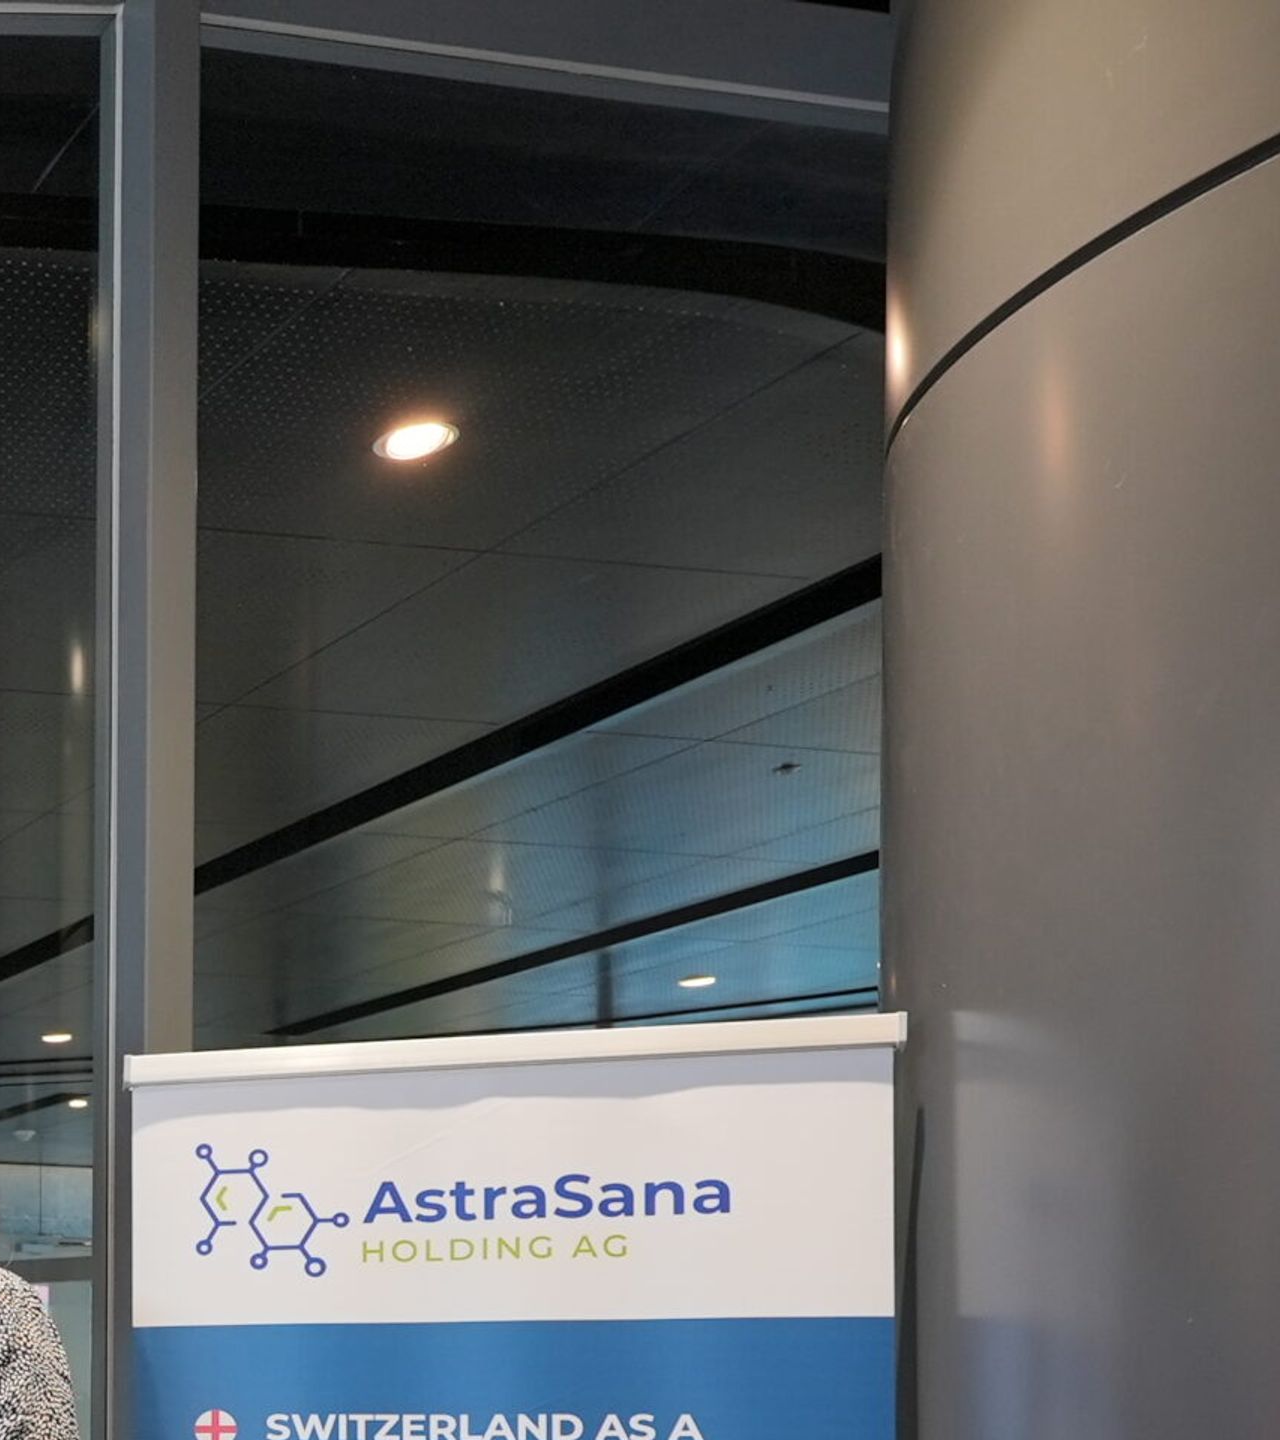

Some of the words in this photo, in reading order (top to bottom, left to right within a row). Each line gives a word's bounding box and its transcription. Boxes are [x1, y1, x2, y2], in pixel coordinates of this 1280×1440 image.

[362, 1172, 732, 1224] AstraSana
[361, 1235, 553, 1264] HOLDING
[571, 1233, 630, 1260] AG
